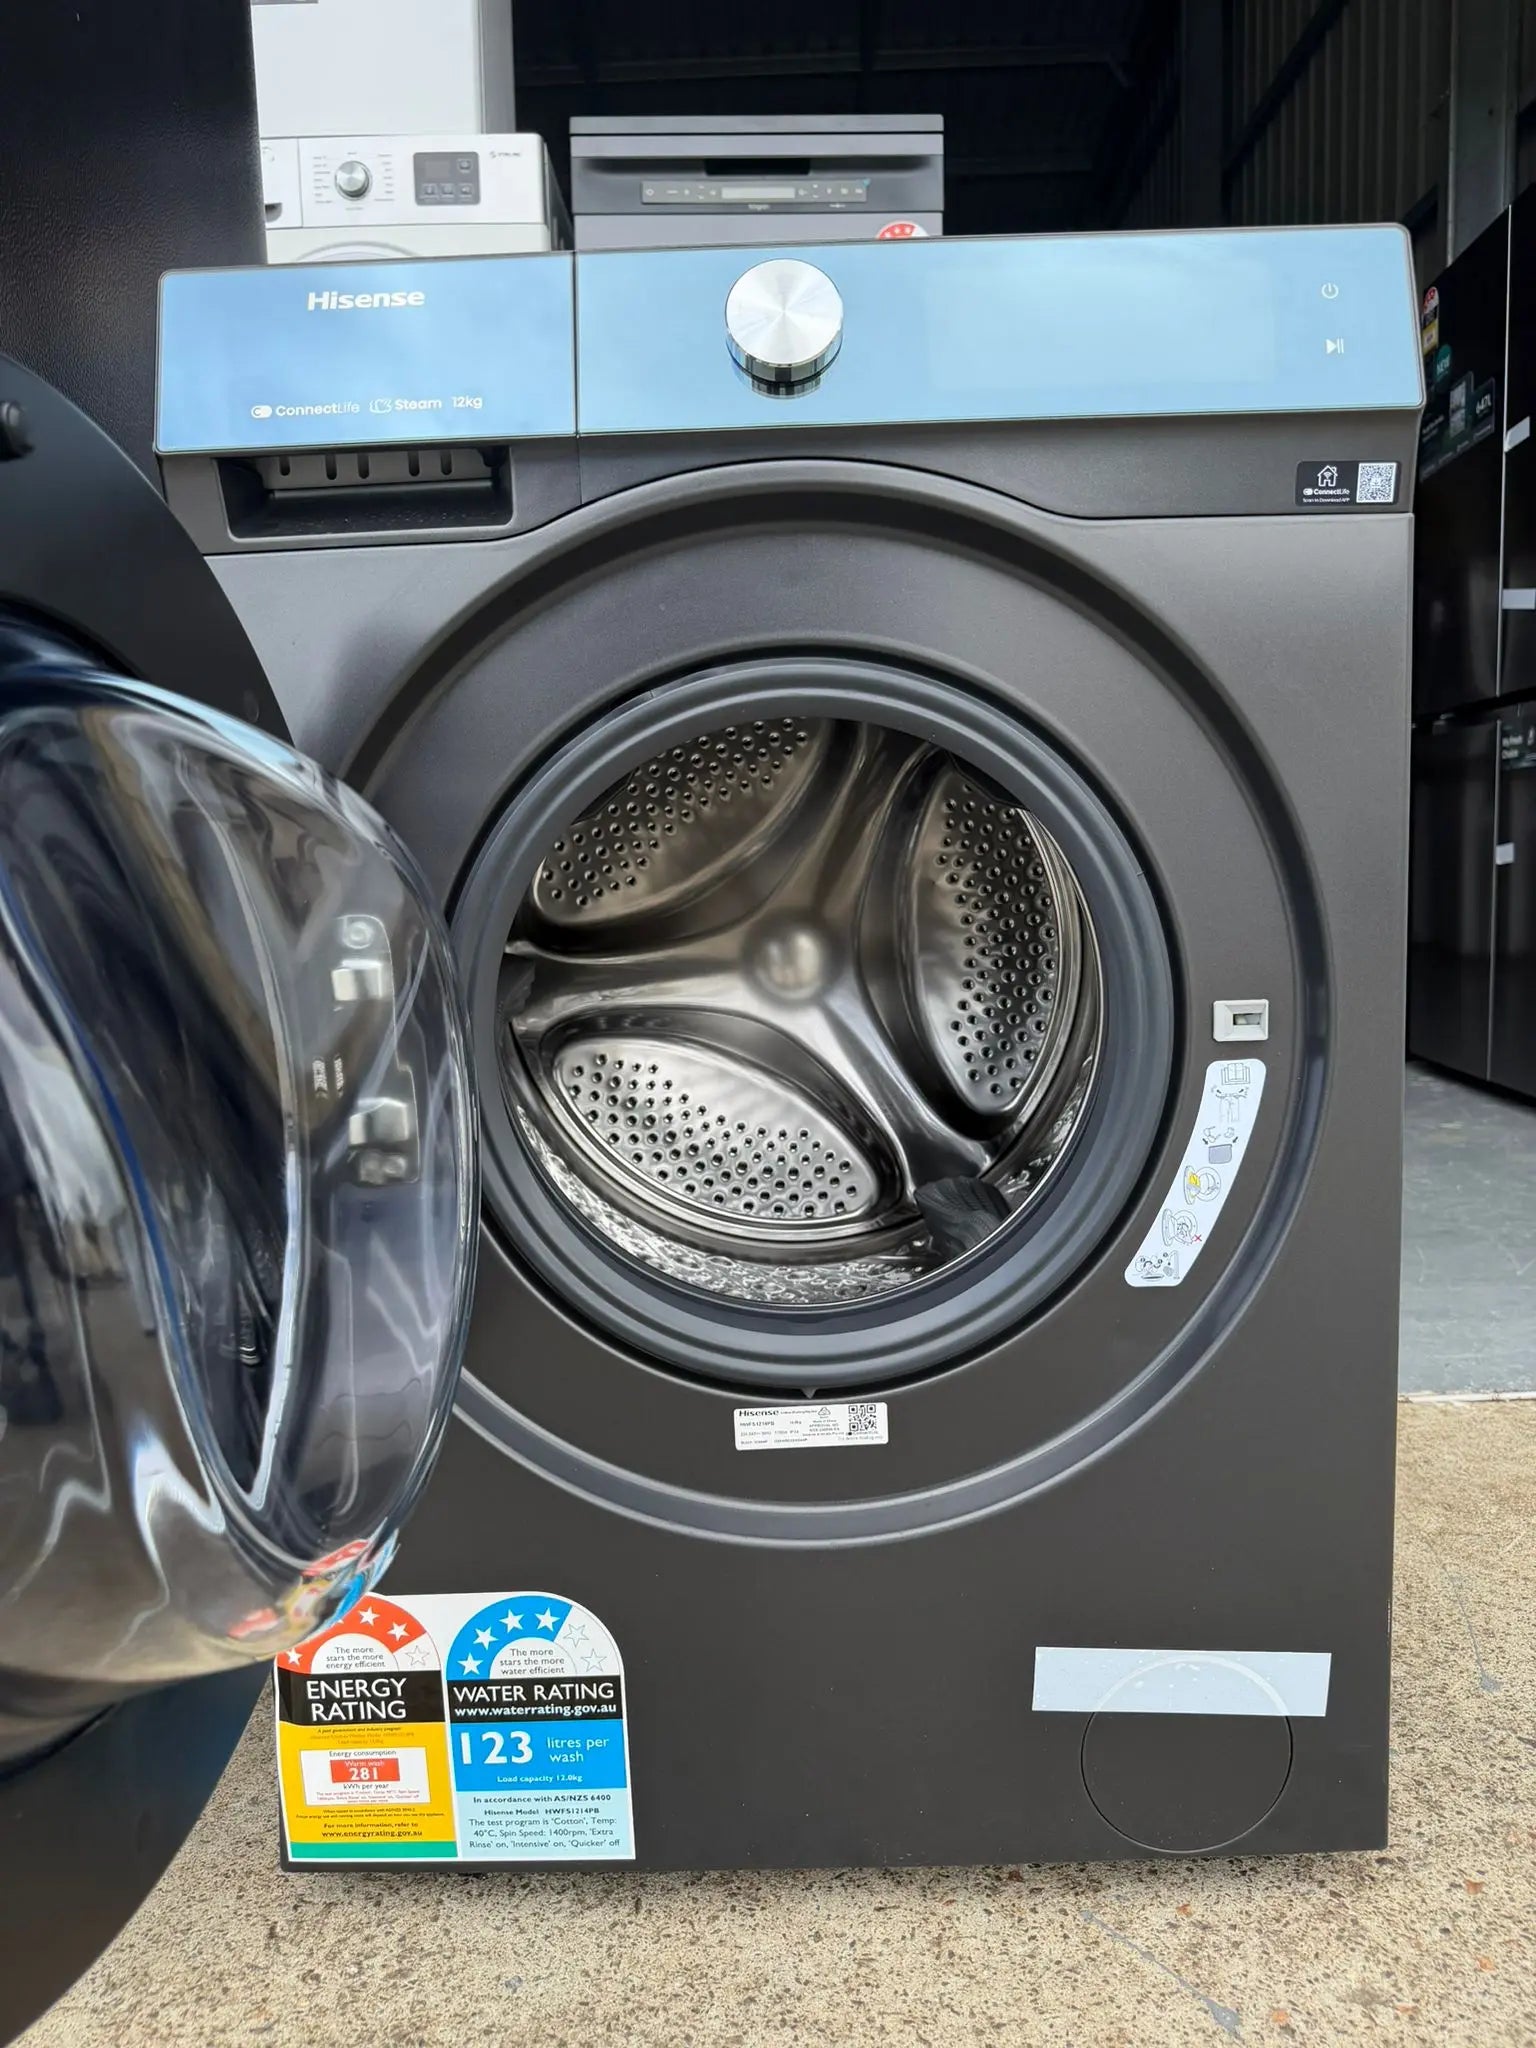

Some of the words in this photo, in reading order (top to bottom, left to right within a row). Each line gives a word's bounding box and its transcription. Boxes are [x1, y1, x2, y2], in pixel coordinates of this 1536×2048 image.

[308, 291, 425, 310] Hisense
[275, 403, 360, 416] ConnectLife
[394, 399, 442, 411] Steam
[452, 396, 482, 409] 12kg
[306, 1678, 406, 1699] ENERGY
[454, 1685, 526, 1703] WATER
[534, 1683, 614, 1700] RATING
[312, 1700, 406, 1721] RATING
[455, 1703, 616, 1716] www.waterrating.gov.au
[460, 1731, 533, 1764] 123
[547, 1737, 581, 1748] litres
[587, 1738, 609, 1751] per
[550, 1752, 583, 1762] wash
[349, 1767, 378, 1780] 281
[520, 1775, 553, 1783] capacity
[591, 1817, 616, 1826] Temp:
[500, 1829, 516, 1838] Spin
[519, 1829, 546, 1838] Speed:
[549, 1829, 587, 1837] 1400rpm,
